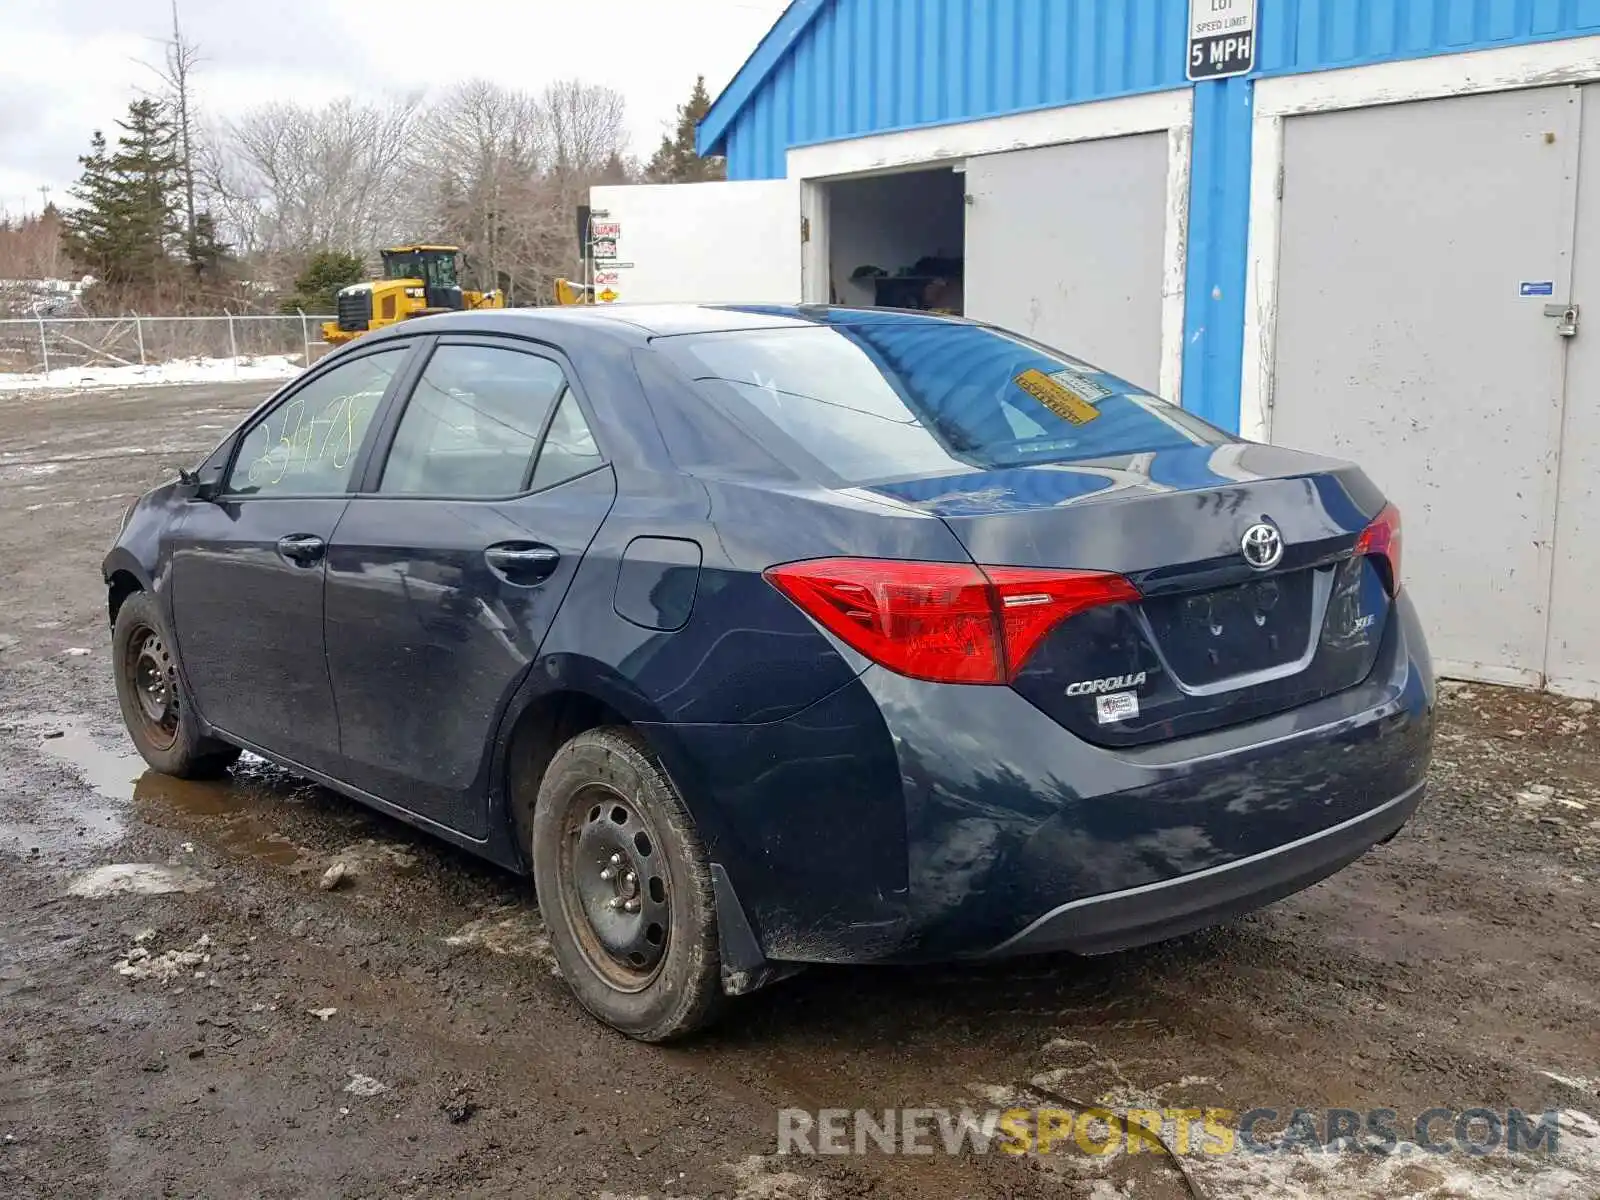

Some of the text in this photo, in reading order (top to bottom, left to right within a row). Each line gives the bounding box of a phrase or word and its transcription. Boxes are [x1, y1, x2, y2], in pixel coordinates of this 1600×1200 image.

[1196, 16, 1248, 33] SPEED LIMIT
[1191, 36, 1251, 67] 5 MPH
[1065, 671, 1147, 697] COROLLA
